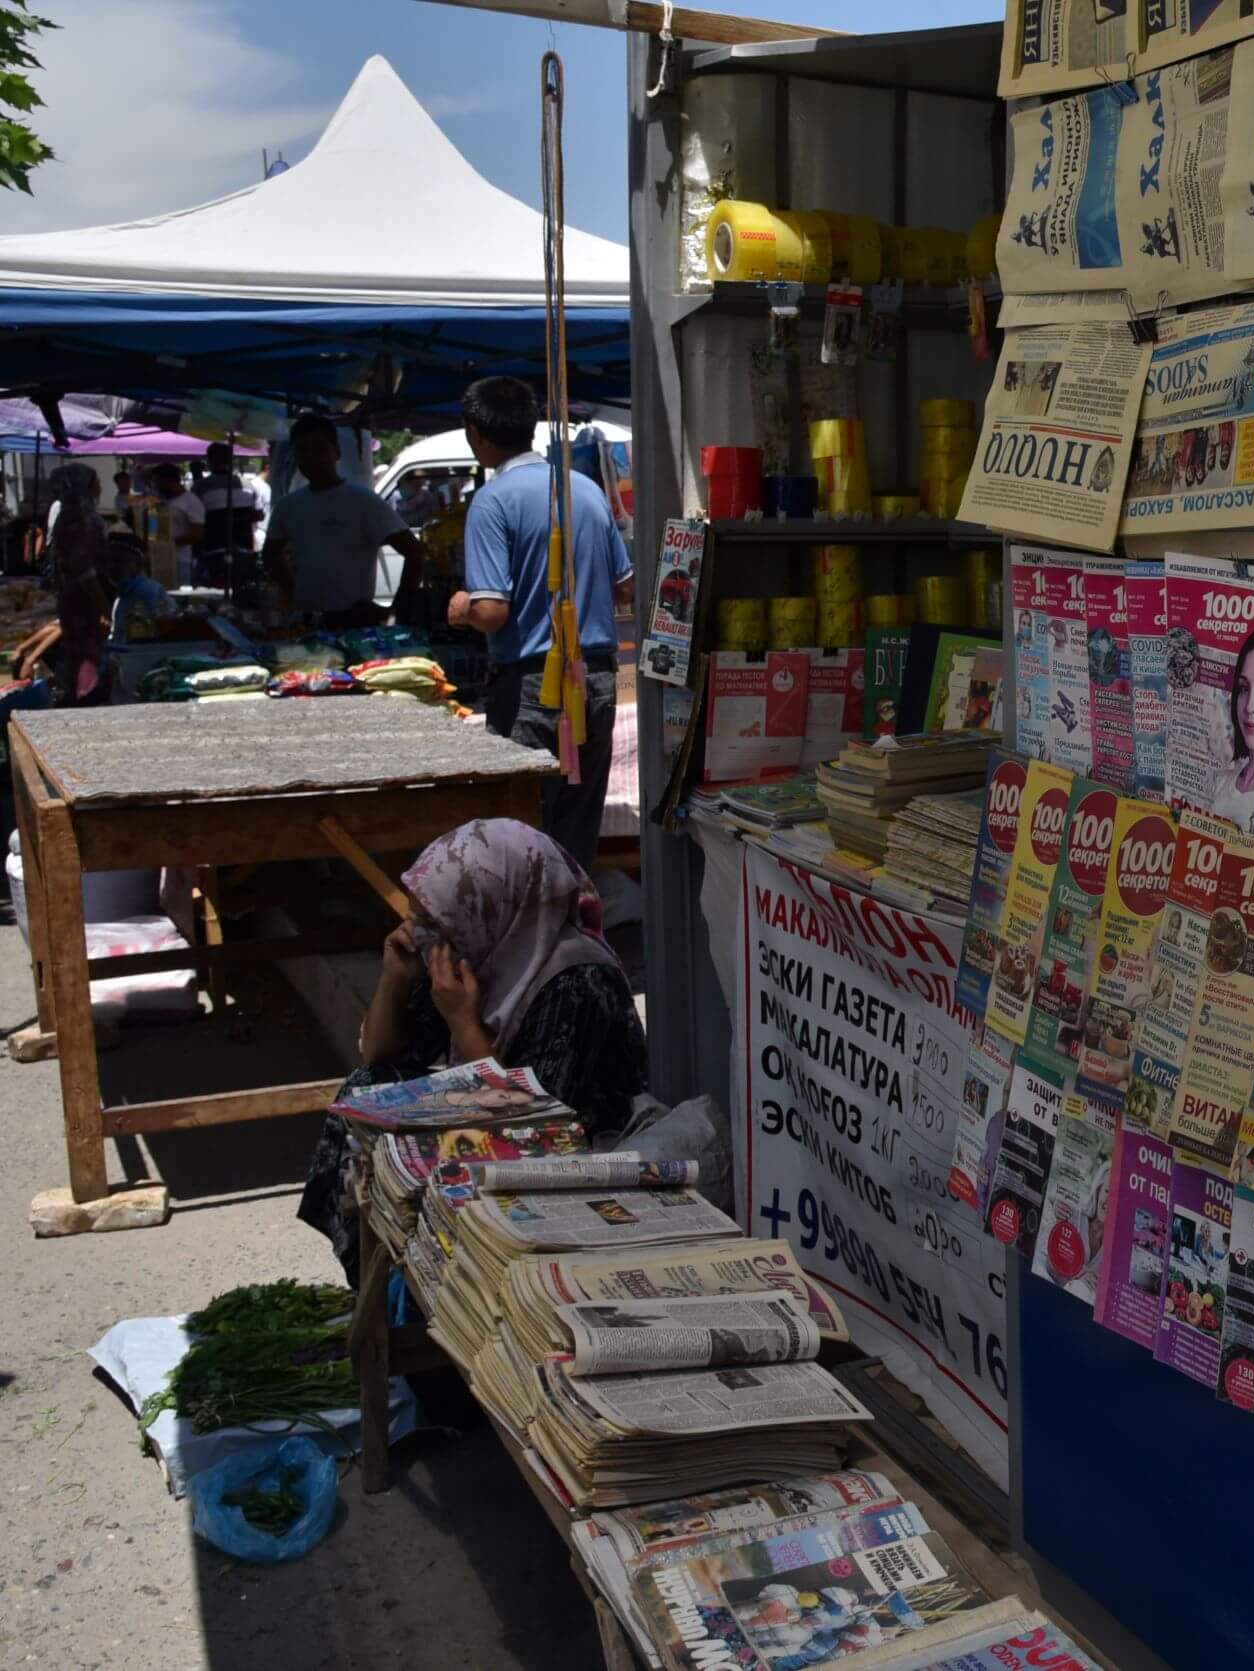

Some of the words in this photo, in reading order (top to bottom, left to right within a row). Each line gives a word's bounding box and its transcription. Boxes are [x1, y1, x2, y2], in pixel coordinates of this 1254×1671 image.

[1060, 181, 1076, 244] ЯНАДА
[982, 431, 1095, 487] HUQUQ
[1179, 489, 1254, 511] АССАЛОМ,
[1197, 618, 1248, 635] секретов
[1119, 837, 1177, 875] 1000
[758, 940, 813, 1002] ЭСКИ
[821, 972, 906, 1054] ГАЗЕТА
[760, 990, 904, 1114] МАКАЛАТУРА
[1193, 1033, 1242, 1056] КОМНАТНЫЕ
[871, 1116, 901, 1165] 1КГ
[1177, 1114, 1217, 1139] больше
[761, 1100, 824, 1164] ЭСКИ
[828, 1138, 896, 1225] КИТОБ
[1237, 1363, 1254, 1378] 130
